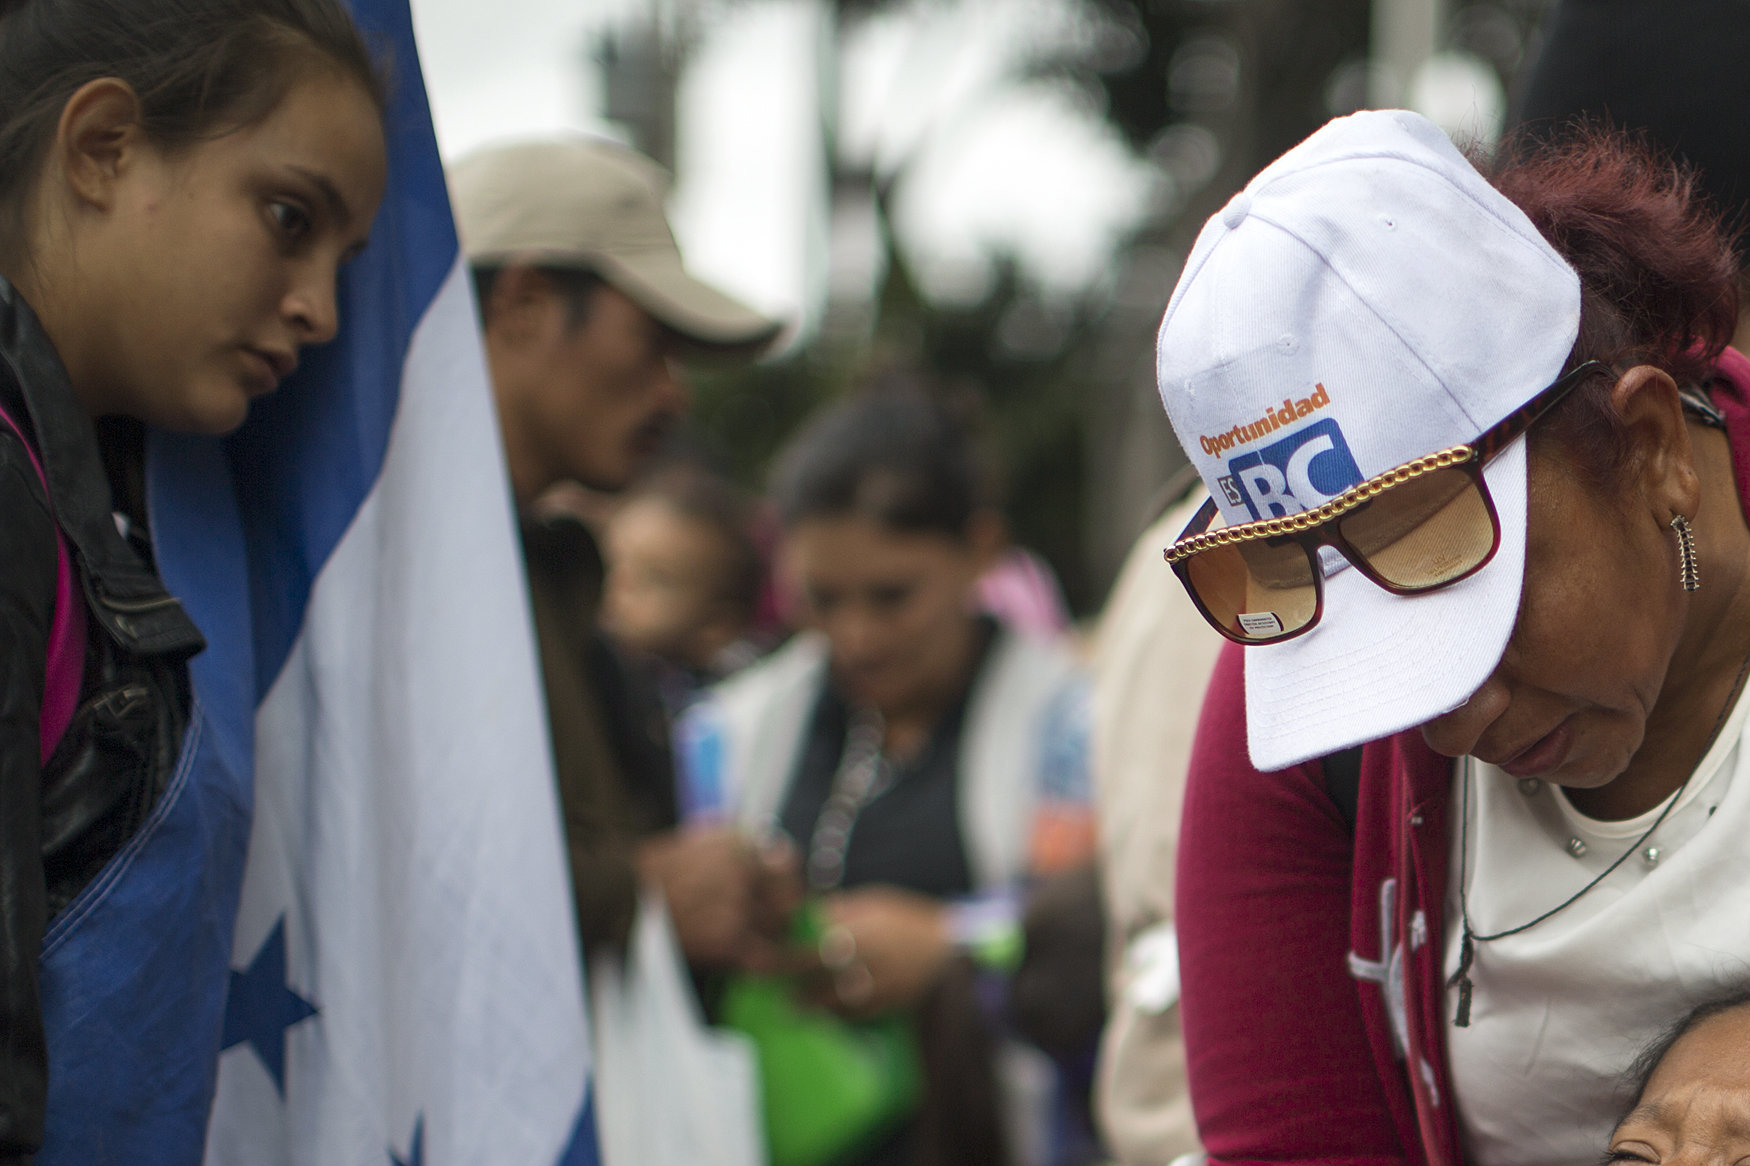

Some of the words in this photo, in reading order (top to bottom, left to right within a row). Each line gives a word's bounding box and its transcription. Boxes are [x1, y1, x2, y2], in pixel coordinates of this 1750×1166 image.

[1200, 382, 1330, 459] Oportunidad
[1220, 477, 1242, 504] ES
[1238, 433, 1354, 521] BC
